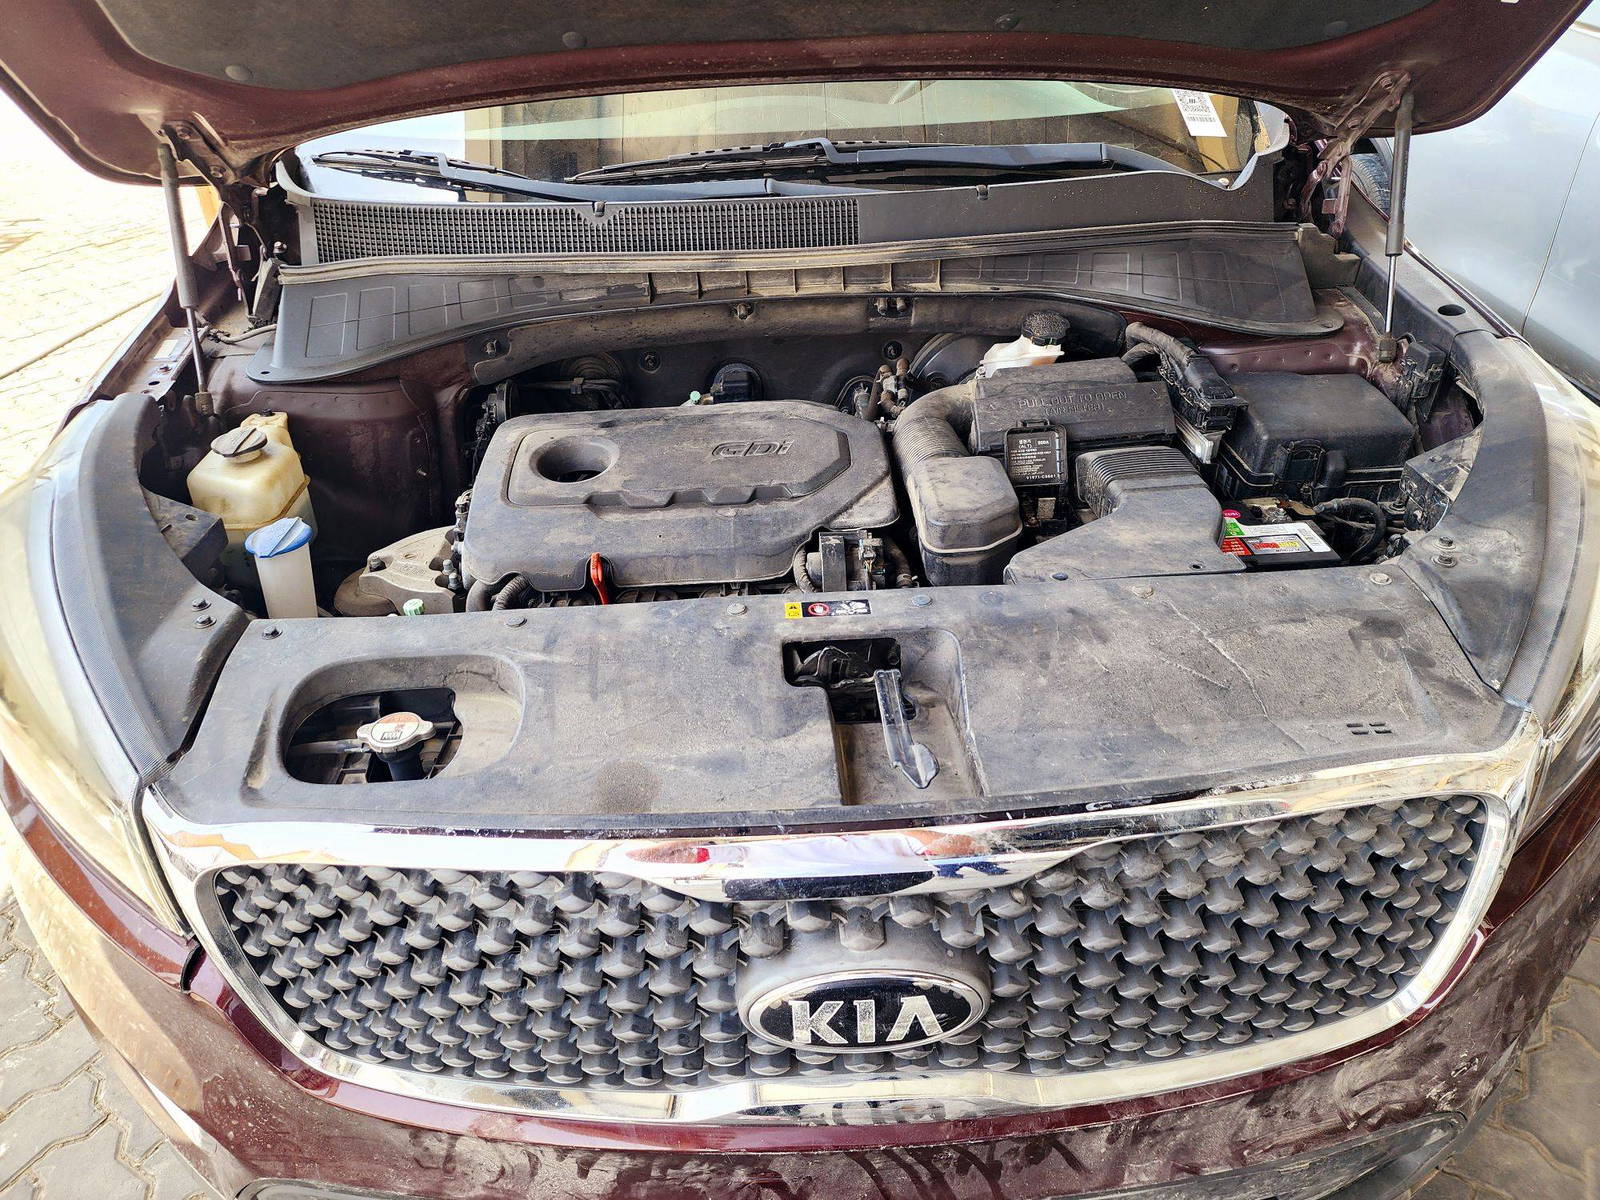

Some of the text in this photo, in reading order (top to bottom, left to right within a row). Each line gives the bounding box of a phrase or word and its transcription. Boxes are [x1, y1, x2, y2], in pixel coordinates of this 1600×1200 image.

[1019, 397, 1051, 409] PULL
[1050, 394, 1074, 406] OUT
[1079, 392, 1093, 402] TO
[788, 994, 944, 1044] KIA
